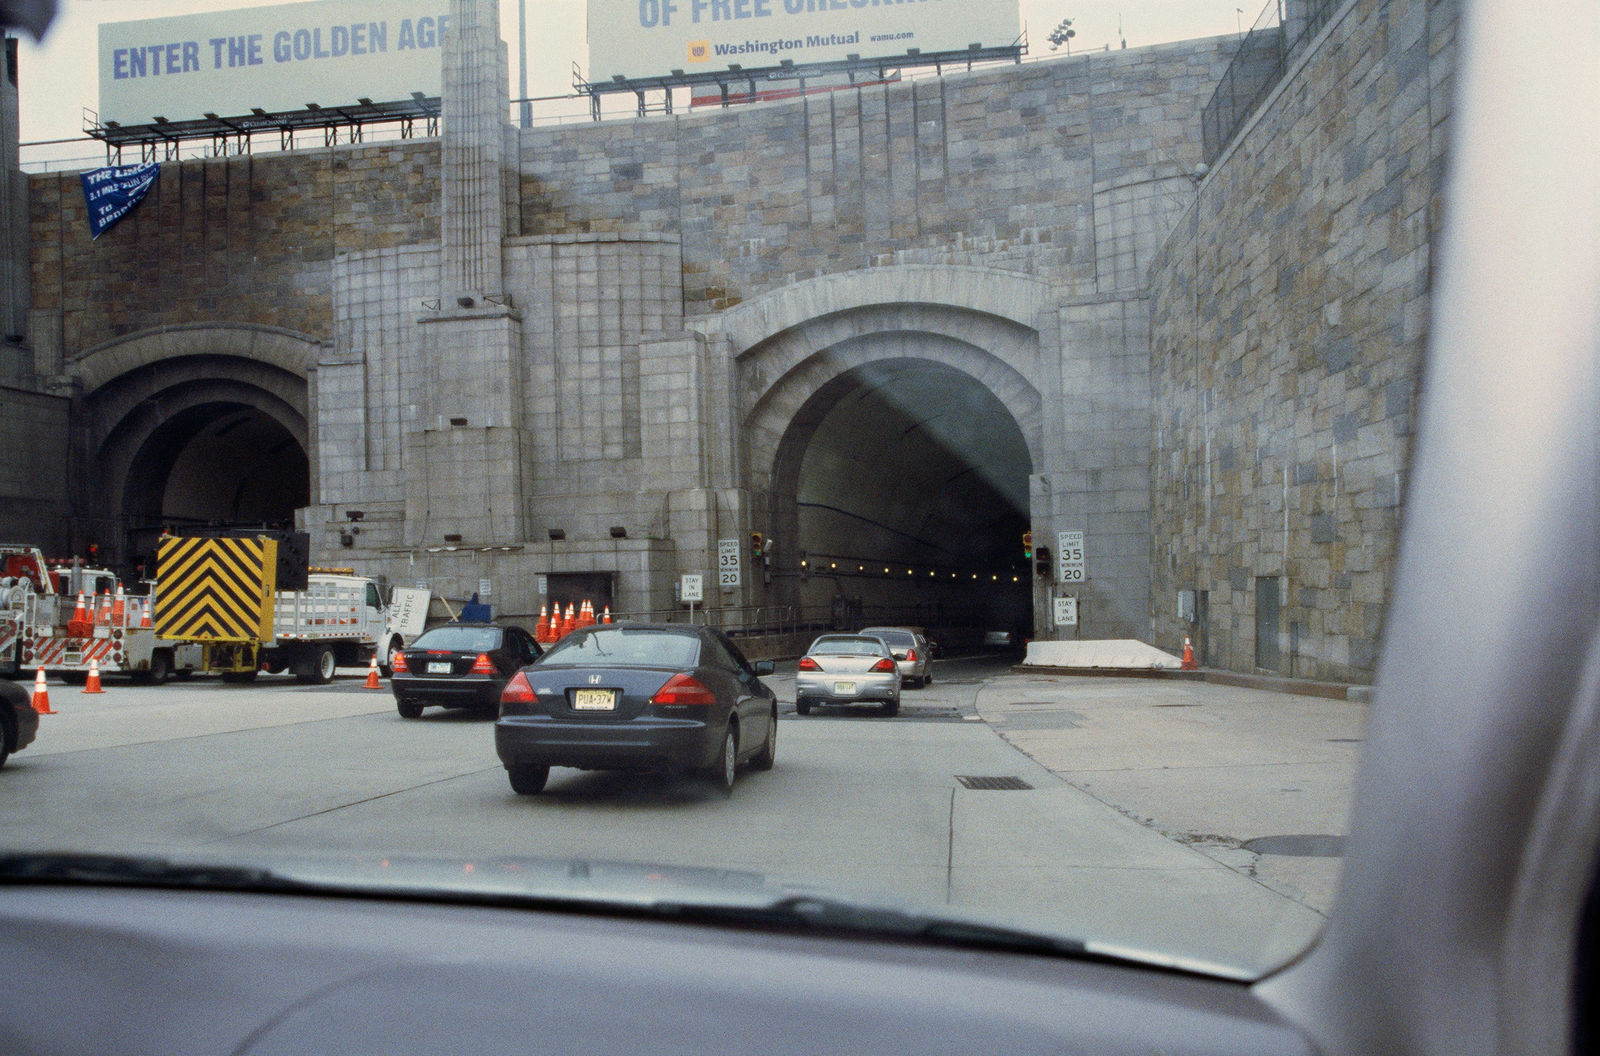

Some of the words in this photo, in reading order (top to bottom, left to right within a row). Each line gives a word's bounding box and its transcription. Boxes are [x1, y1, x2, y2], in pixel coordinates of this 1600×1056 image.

[639, 0, 677, 28] OF
[113, 41, 200, 79] ENTER
[209, 34, 263, 69] THE
[273, 21, 388, 63] GOLDEN
[715, 38, 802, 56] Washington
[806, 31, 859, 47] Mutual
[870, 31, 914, 42] wamu.com
[88, 170, 112, 184] THE
[89, 190, 101, 201] 3.1
[721, 555, 738, 566] 35
[1062, 549, 1082, 560] 35
[722, 574, 737, 583] 20
[1064, 569, 1082, 580] 20
[392, 602, 402, 619] ALL
[400, 594, 414, 628] TRAFFIC
